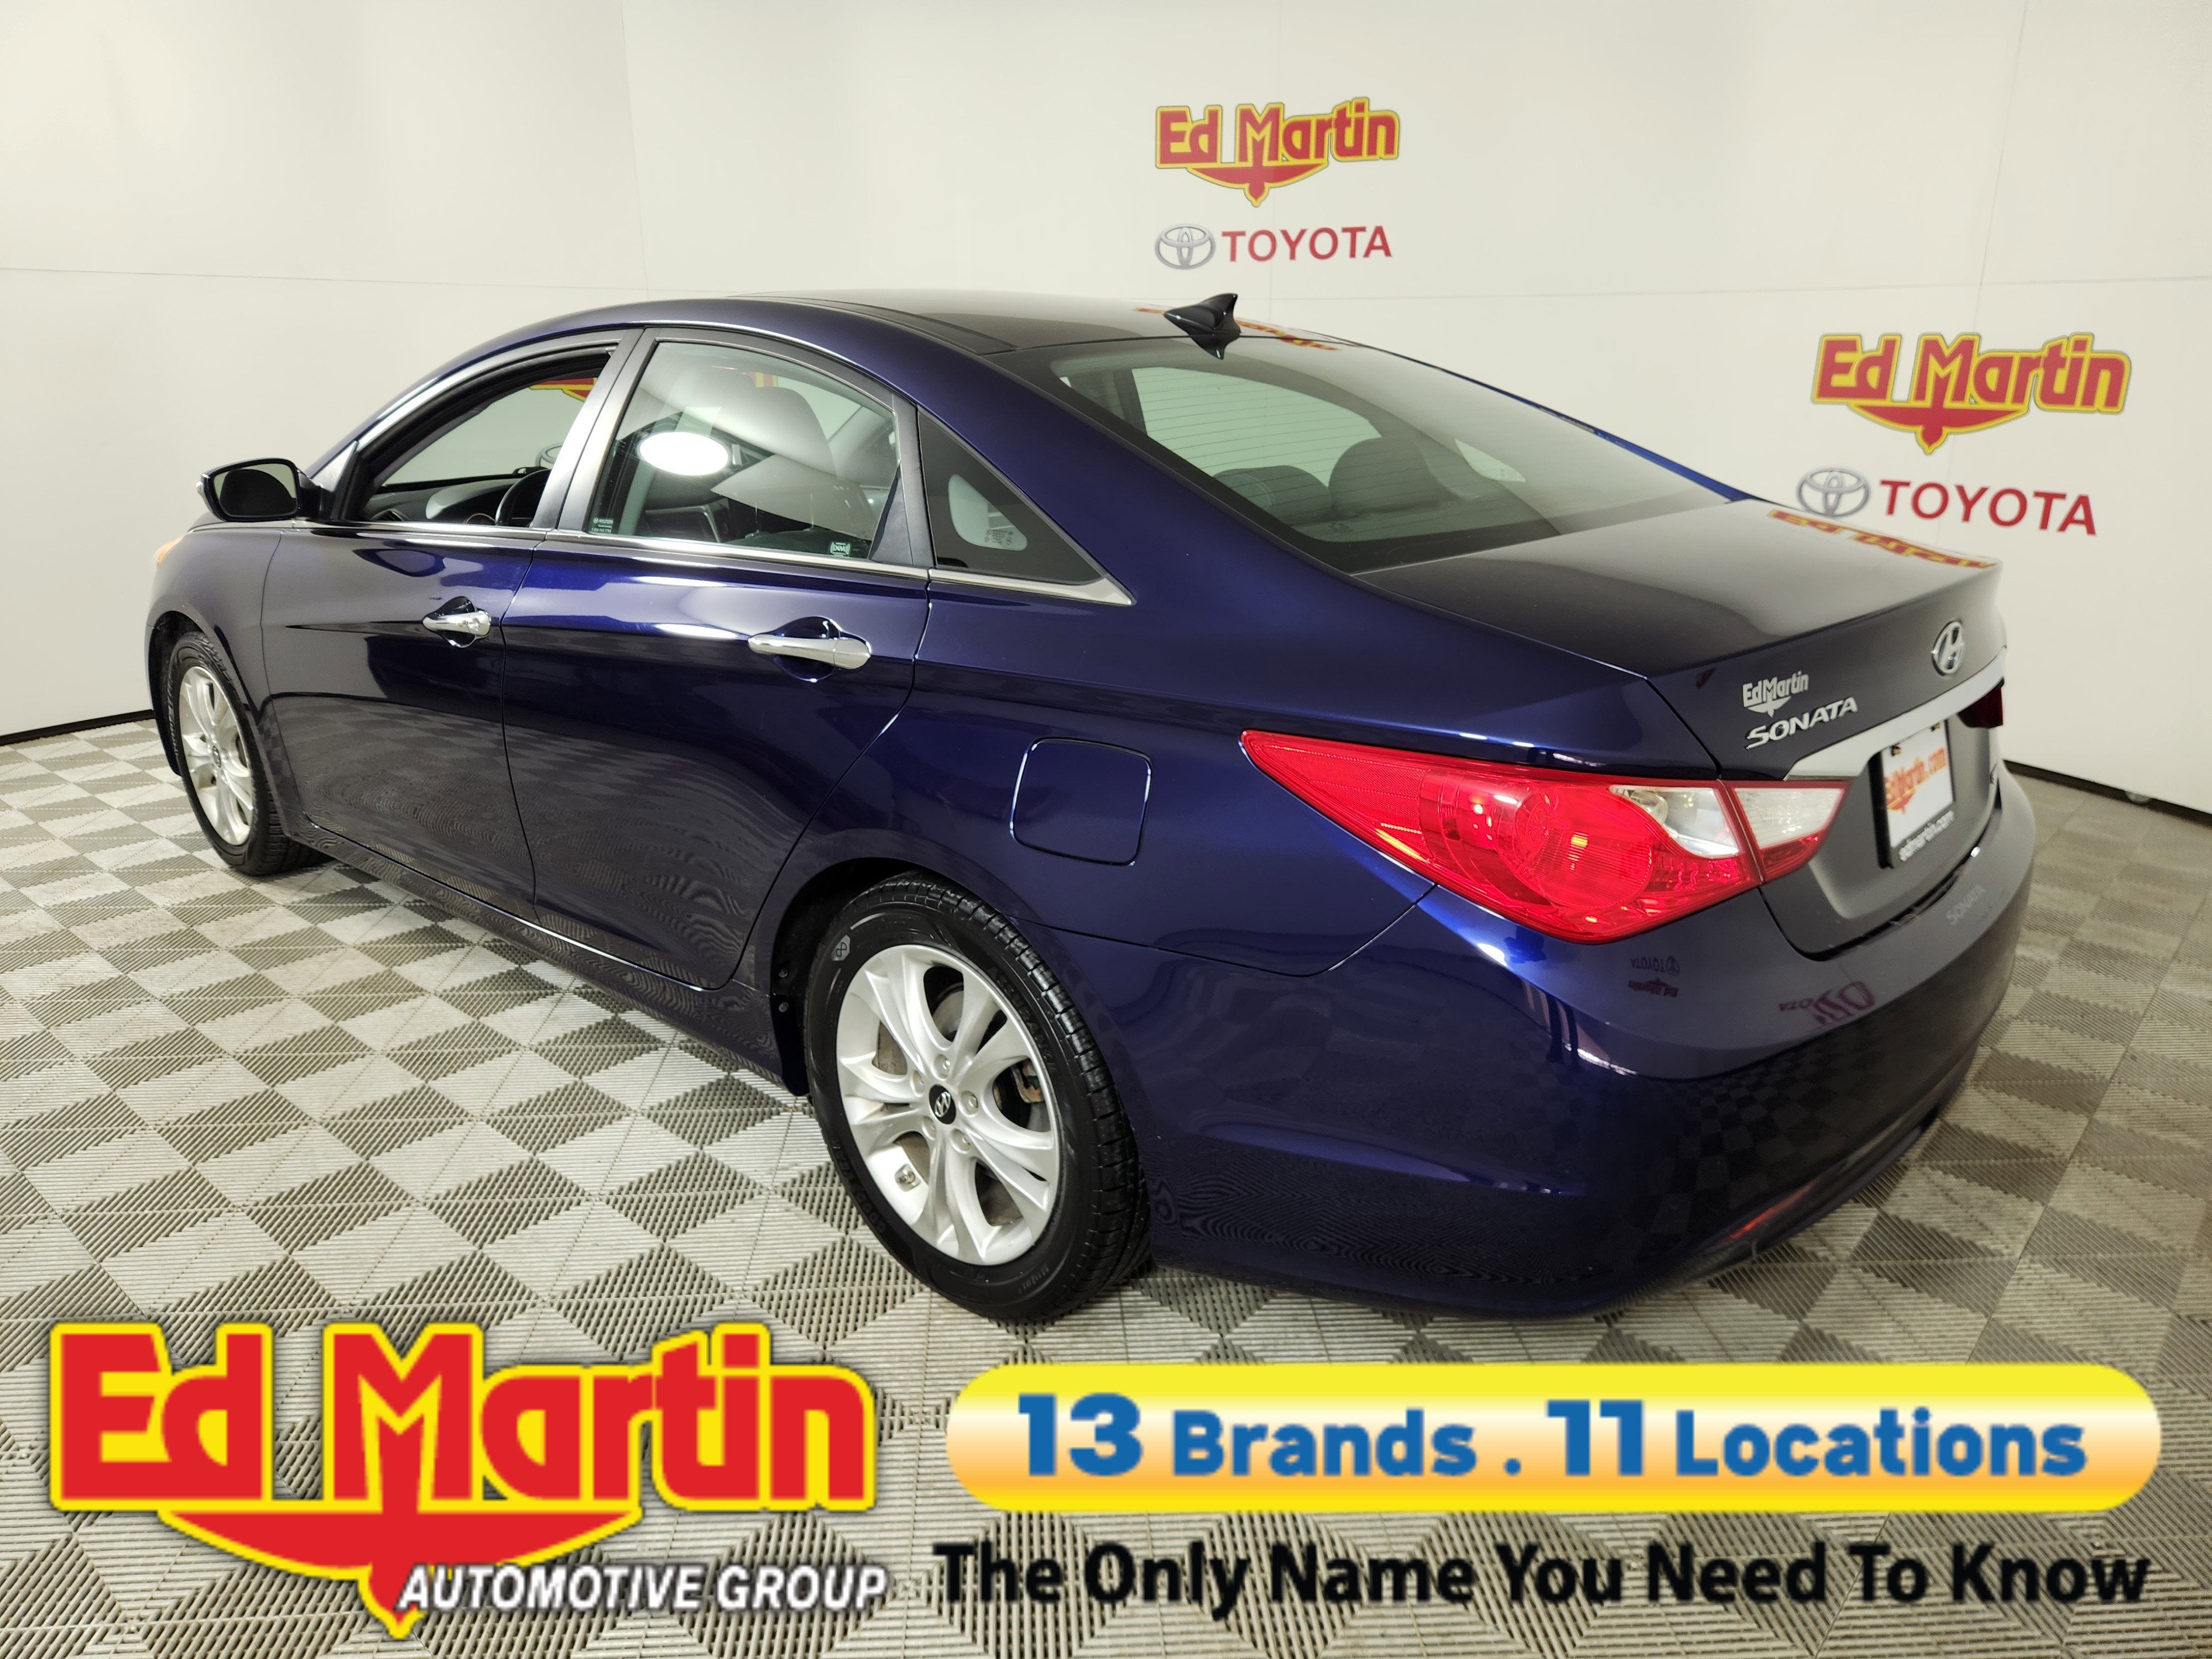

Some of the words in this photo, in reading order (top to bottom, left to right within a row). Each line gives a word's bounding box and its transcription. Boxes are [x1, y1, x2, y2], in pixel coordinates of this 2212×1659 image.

[1156, 105, 1222, 168] Ed
[1236, 97, 1400, 165] Martin
[1221, 226, 1393, 262] TOYOTA
[1811, 332, 1902, 403] Ed
[1909, 332, 2132, 414] Martin
[1880, 479, 2098, 535] TOYOTA
[1744, 696, 1858, 750] SONATA
